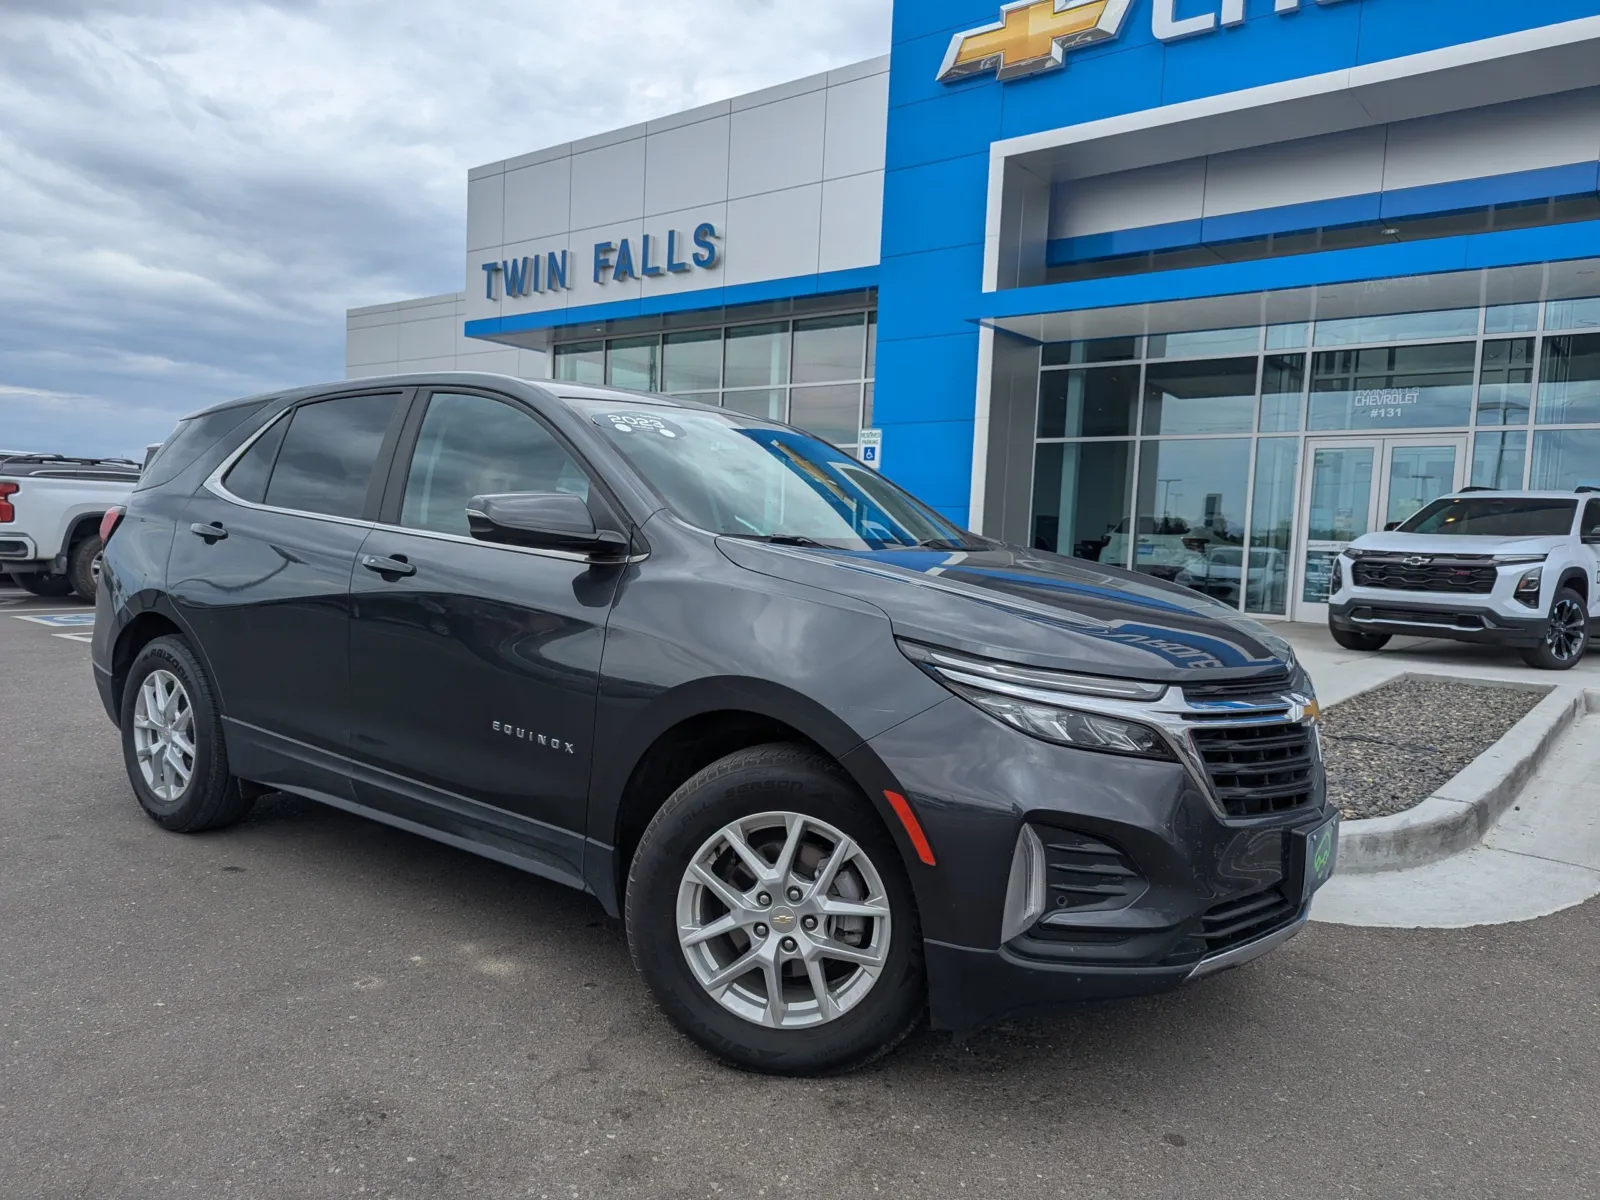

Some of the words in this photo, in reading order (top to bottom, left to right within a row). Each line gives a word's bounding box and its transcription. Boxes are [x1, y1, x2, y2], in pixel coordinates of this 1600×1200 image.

[482, 249, 572, 300] TWIN
[593, 222, 720, 285] FALLS
[1354, 393, 1419, 407] CHEVROLET
[1370, 407, 1402, 418] #131
[607, 414, 665, 429] 2023
[492, 720, 574, 754] EQUINOX
[724, 779, 804, 799] SEASON
